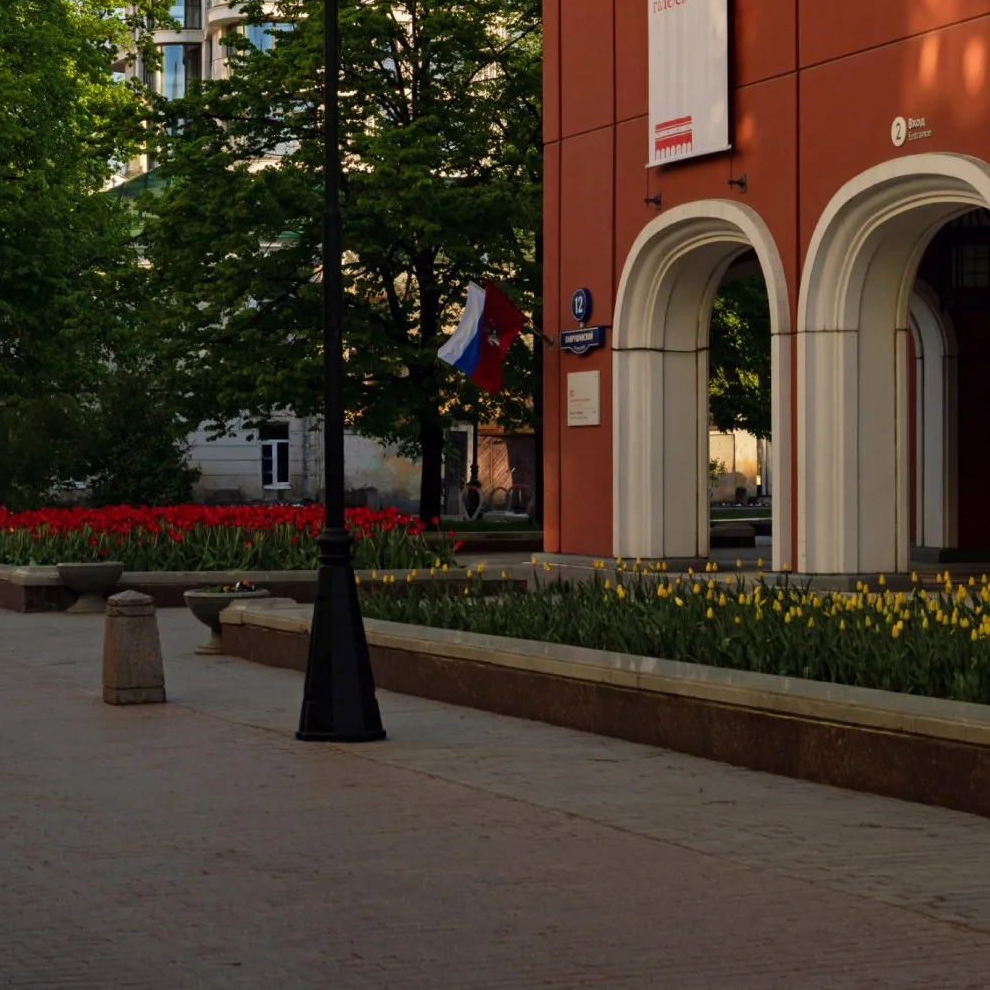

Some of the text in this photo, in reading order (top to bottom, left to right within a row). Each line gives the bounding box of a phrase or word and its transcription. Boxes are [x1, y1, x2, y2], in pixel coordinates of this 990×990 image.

[908, 118, 925, 129] Вход
[896, 122, 901, 140] 2
[908, 130, 931, 140] Entrance
[574, 296, 583, 314] 12
